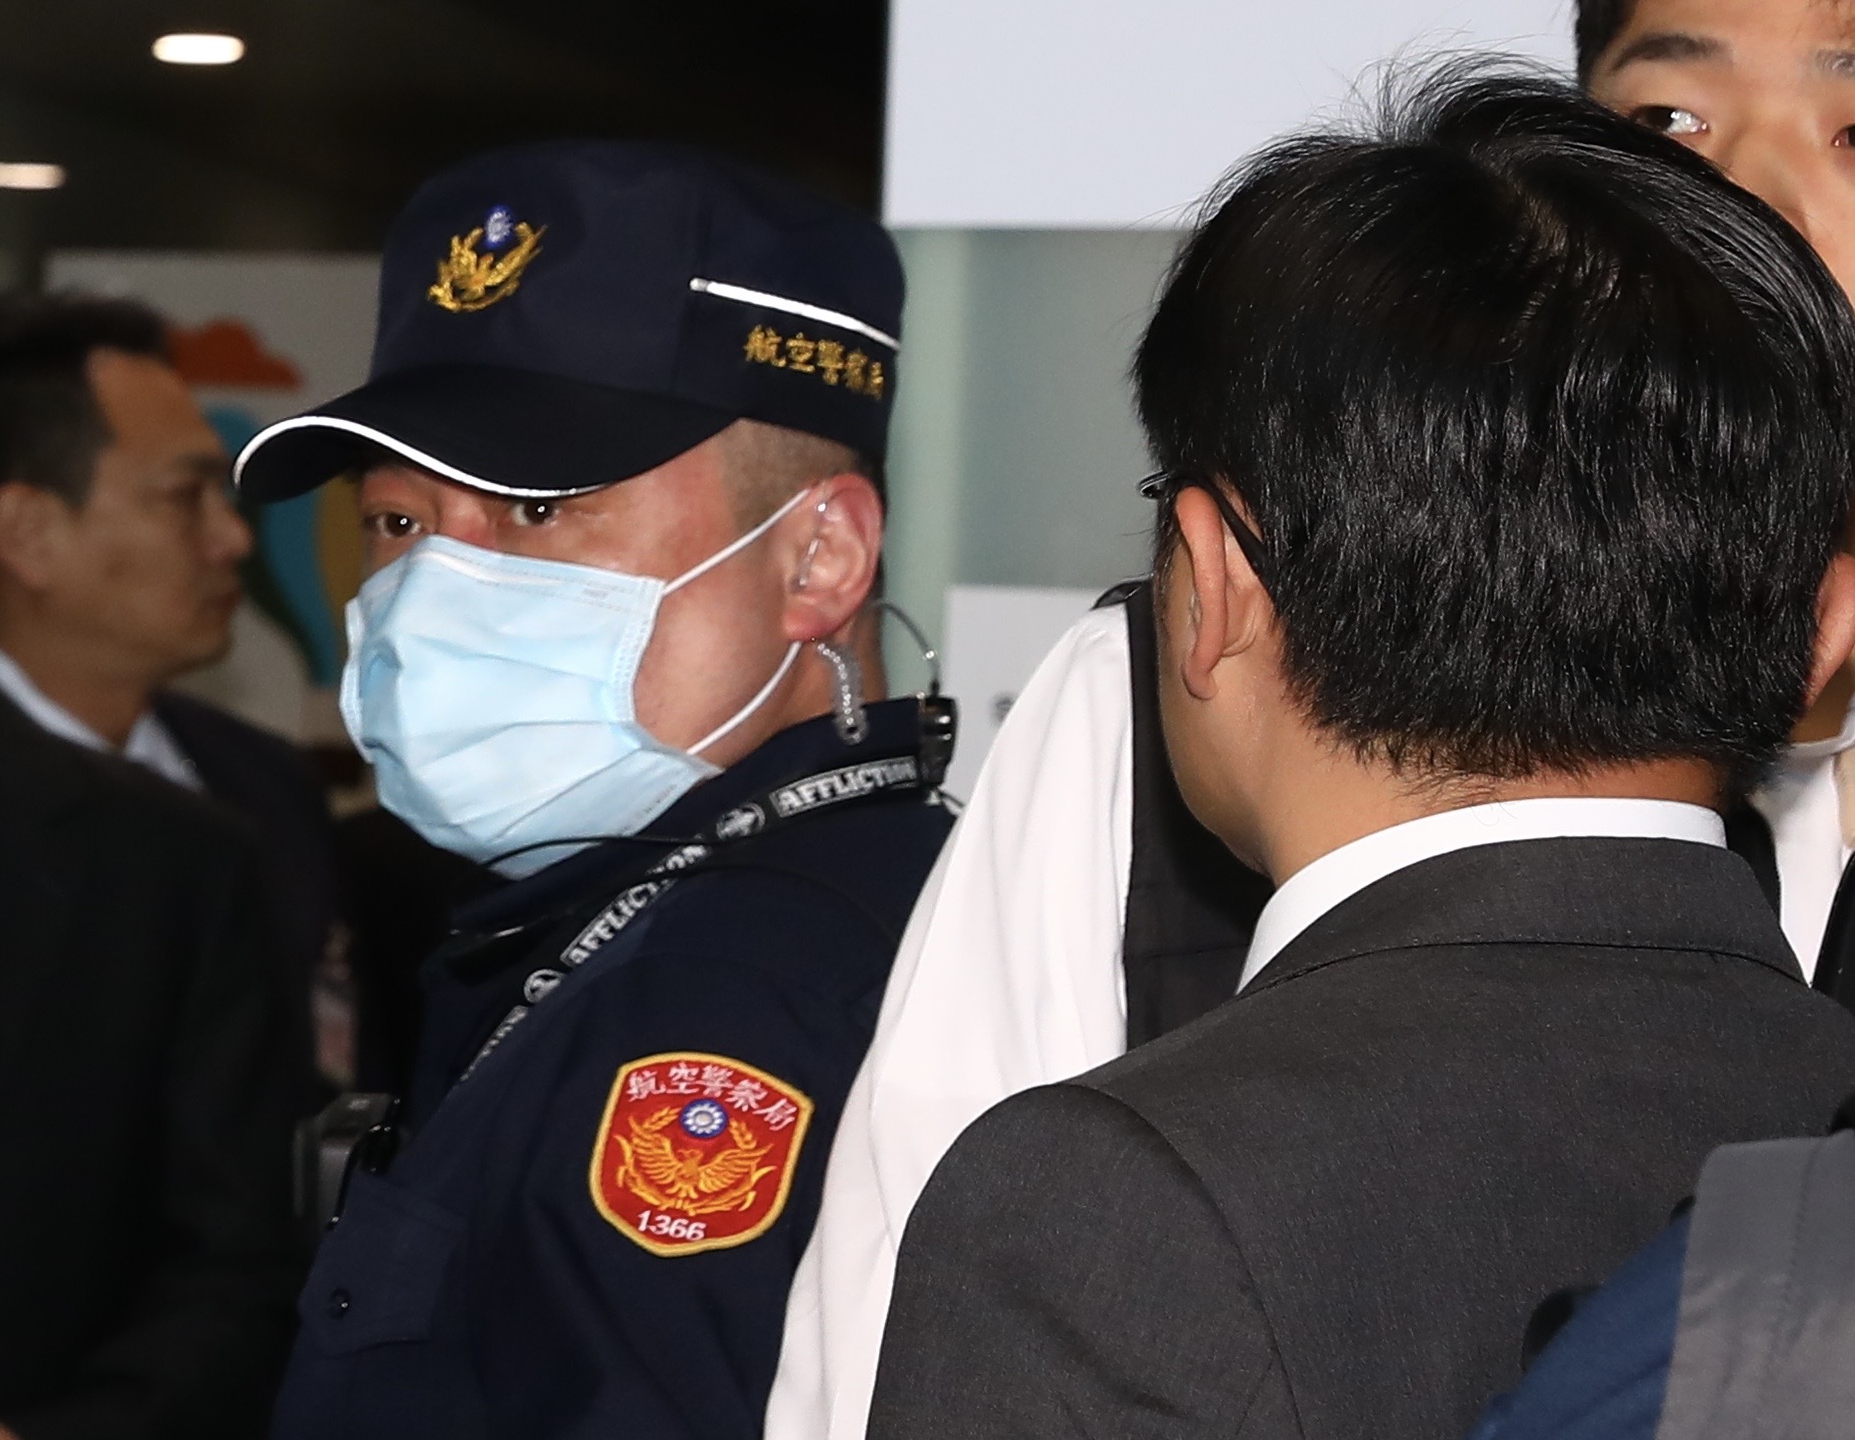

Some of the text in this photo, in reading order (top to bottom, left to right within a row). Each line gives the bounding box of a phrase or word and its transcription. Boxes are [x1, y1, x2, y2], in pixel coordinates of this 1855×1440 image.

[626, 1061, 797, 1131] 航空警察局
[638, 1210, 707, 1241] 1366
